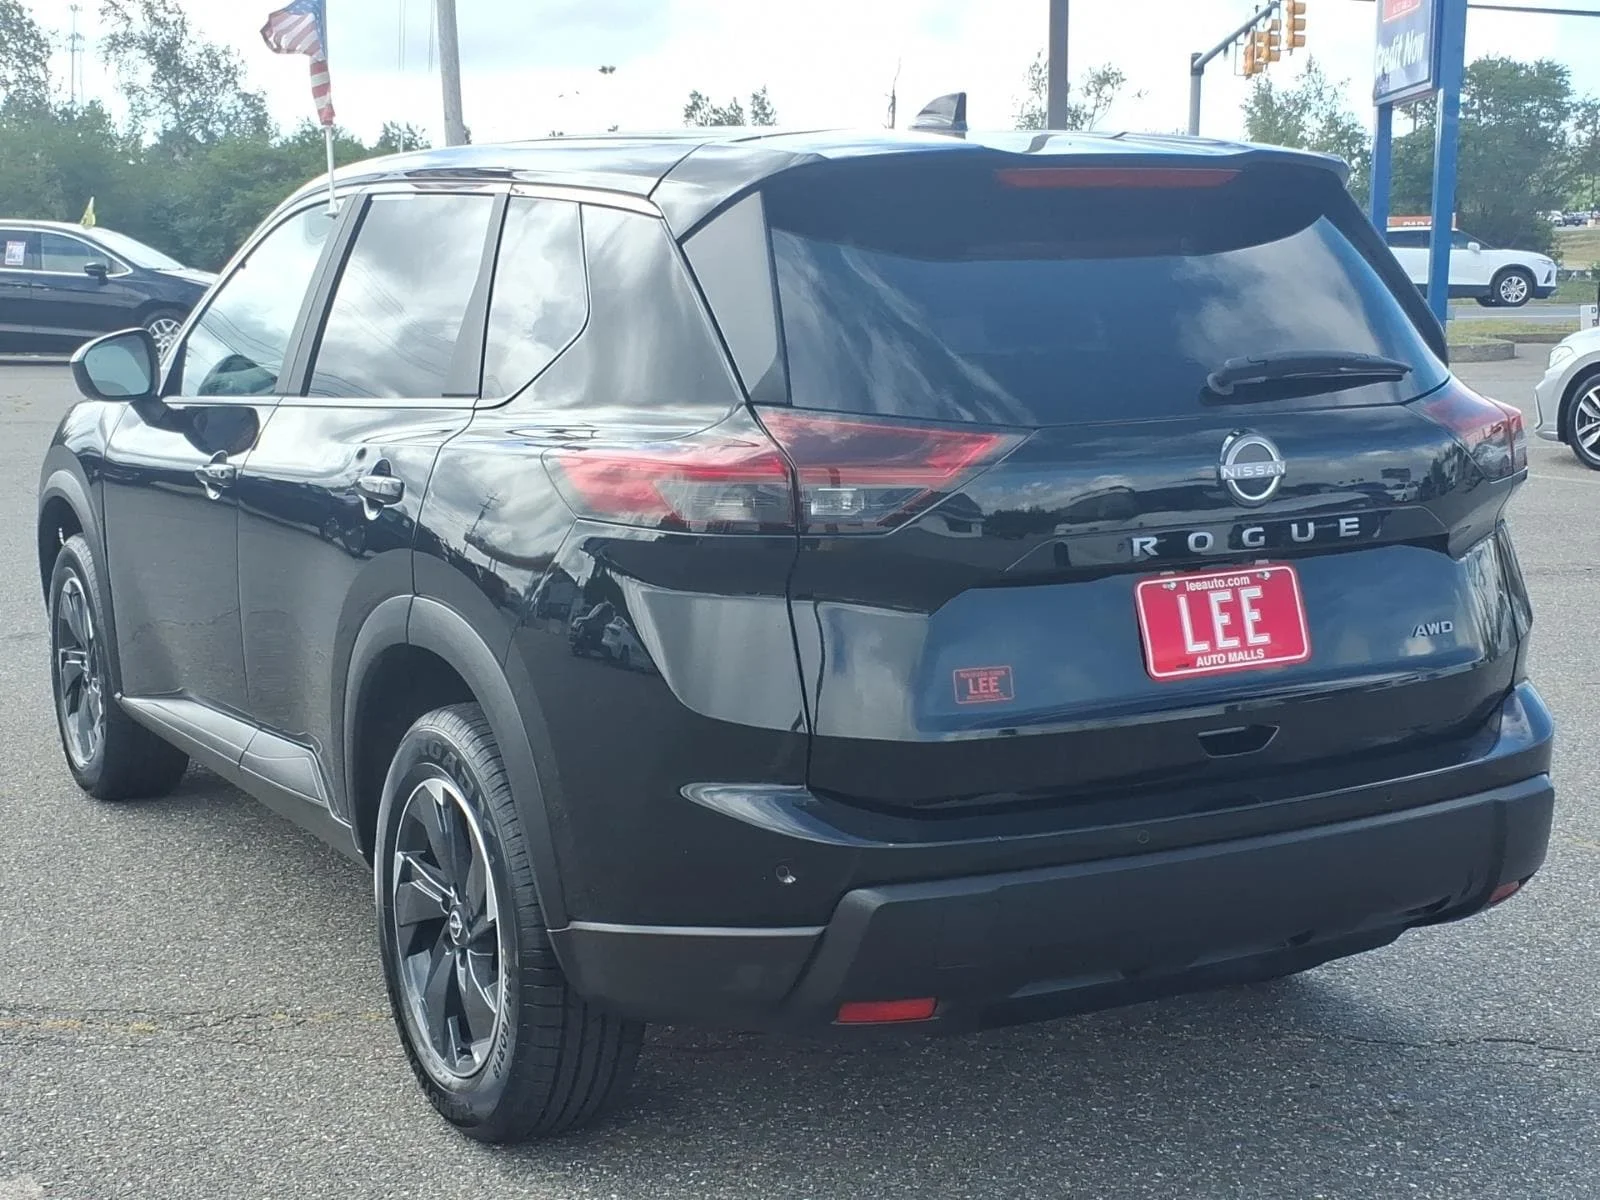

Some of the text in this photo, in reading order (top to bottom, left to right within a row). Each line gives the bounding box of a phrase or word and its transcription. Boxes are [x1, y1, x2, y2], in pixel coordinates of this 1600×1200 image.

[1403, 29, 1425, 67] Now
[1221, 461, 1286, 478] NISSAN
[1131, 516, 1361, 557] ROGUE
[1185, 575, 1251, 592] leeauto.com
[1177, 585, 1271, 655] LEE
[1411, 619, 1454, 638] AWD
[1196, 648, 1265, 668] AUTO MALLS
[968, 676, 1000, 694] LEE
